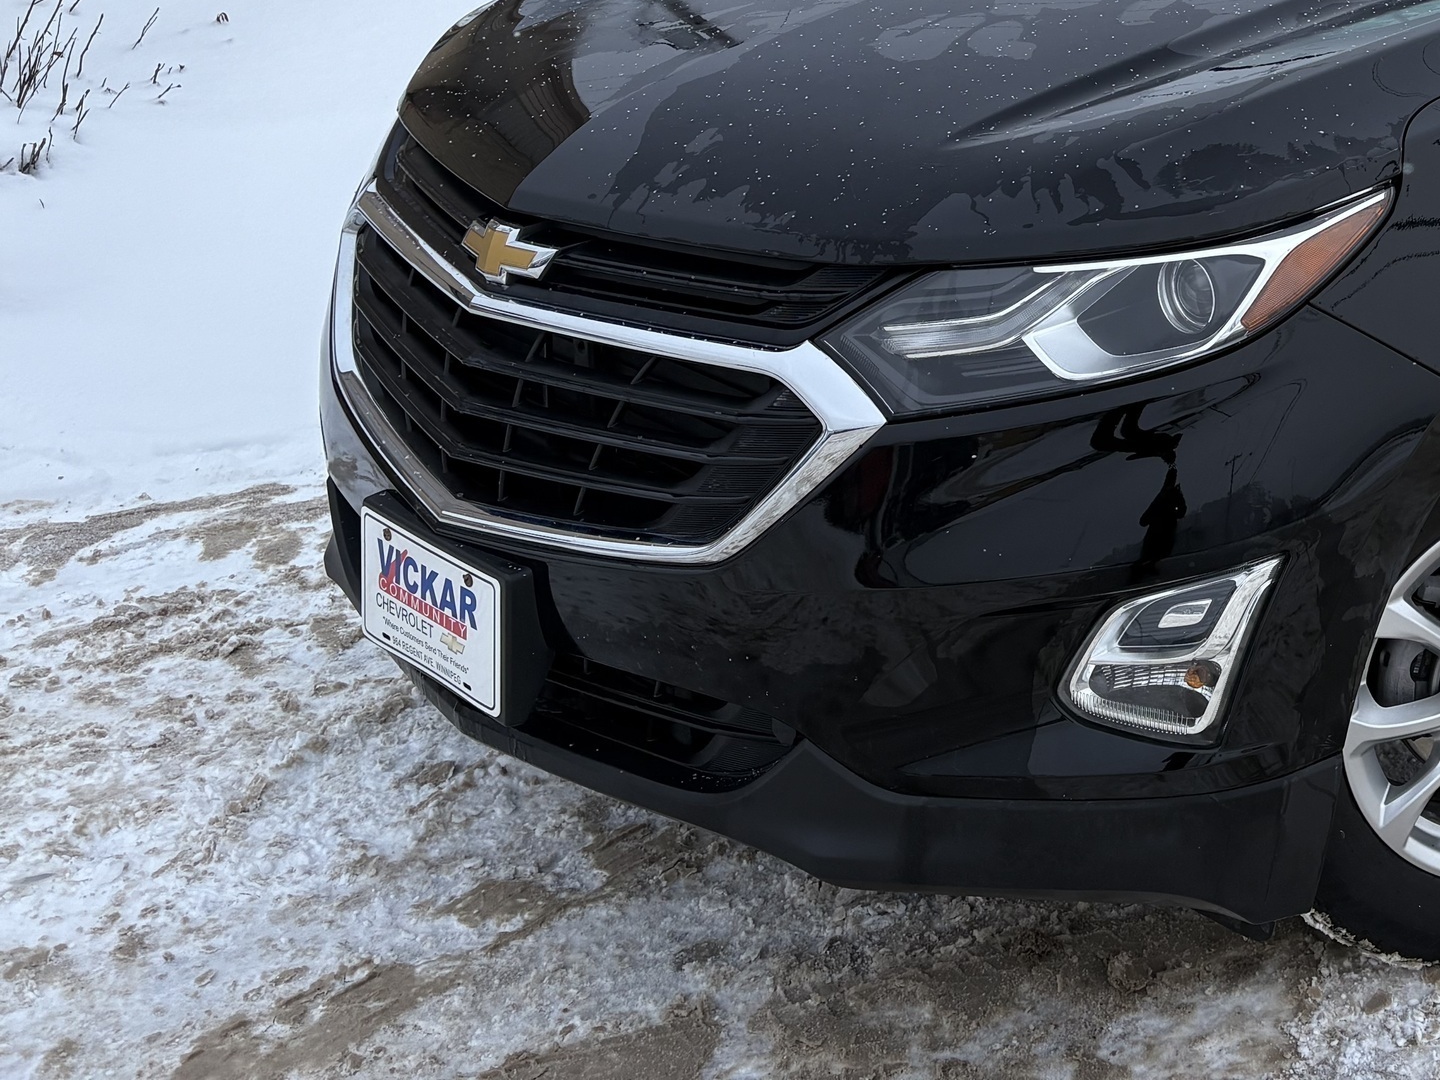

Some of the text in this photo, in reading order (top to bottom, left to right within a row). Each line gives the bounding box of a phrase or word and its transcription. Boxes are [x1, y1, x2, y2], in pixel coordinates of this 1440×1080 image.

[376, 537, 478, 631] VICKAR
[378, 576, 468, 639] COMMUNITY
[376, 592, 435, 639] CHEVROLET
[399, 626, 424, 648] Customers
[401, 639, 423, 660] REGENT
[436, 660, 462, 685] WINNIPEG
